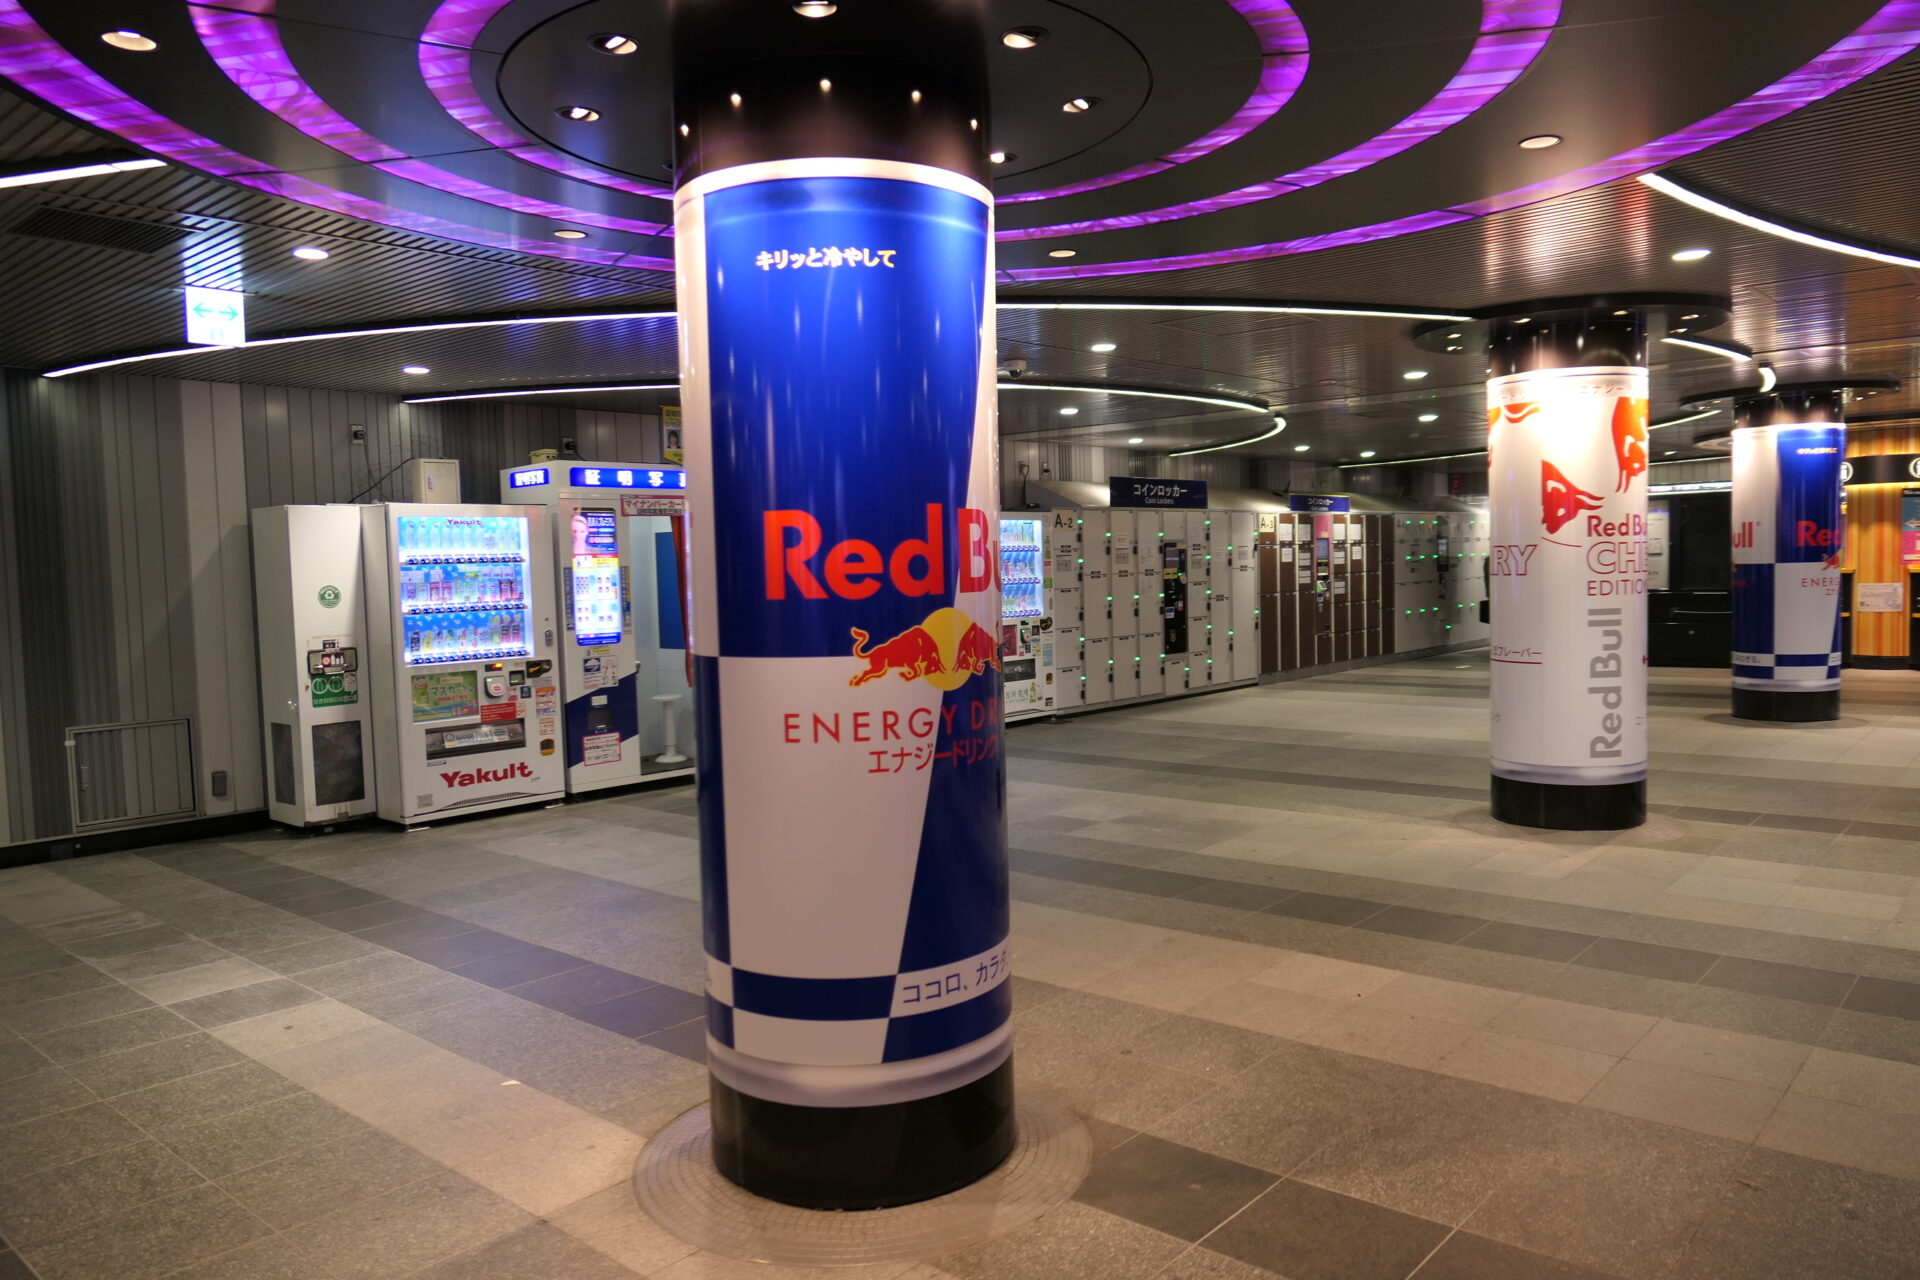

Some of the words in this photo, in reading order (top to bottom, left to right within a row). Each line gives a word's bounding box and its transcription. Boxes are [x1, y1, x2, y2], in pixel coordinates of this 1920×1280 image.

[755, 246, 897, 270] キリッと冷やして
[1133, 483, 1188, 497] コインロッカー
[1145, 496, 1157, 504] Coin
[1054, 513, 1073, 528] A-2
[1260, 516, 1274, 529] A-3
[1586, 513, 1630, 538] Red
[763, 503, 944, 600] Red
[1490, 544, 1538, 576] RY
[1587, 607, 1623, 679] Bull
[784, 704, 957, 744] ENERGY
[1587, 686, 1623, 759] Red
[868, 734, 999, 774] エナジードリンク
[440, 761, 534, 788] Yakult
